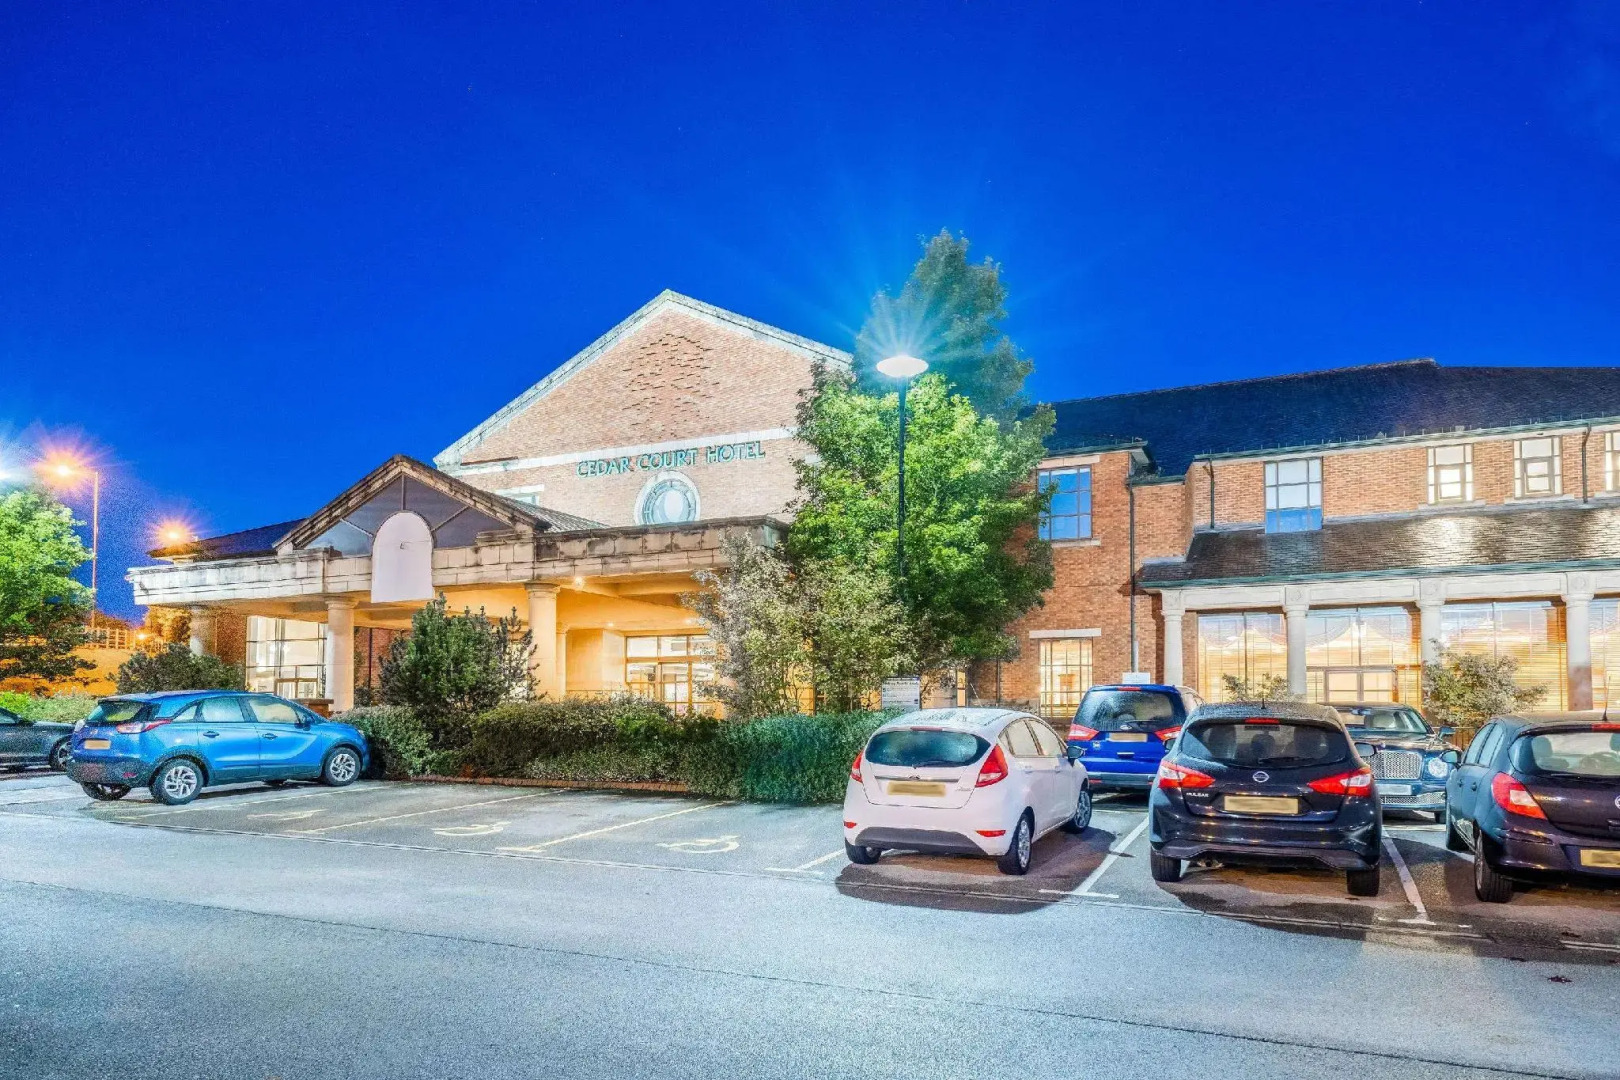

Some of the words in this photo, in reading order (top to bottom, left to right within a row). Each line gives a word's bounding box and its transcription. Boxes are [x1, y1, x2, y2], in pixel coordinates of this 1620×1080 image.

[577, 457, 632, 478] CEDAR
[637, 448, 698, 470] COURT
[706, 441, 766, 463] HOTEL
